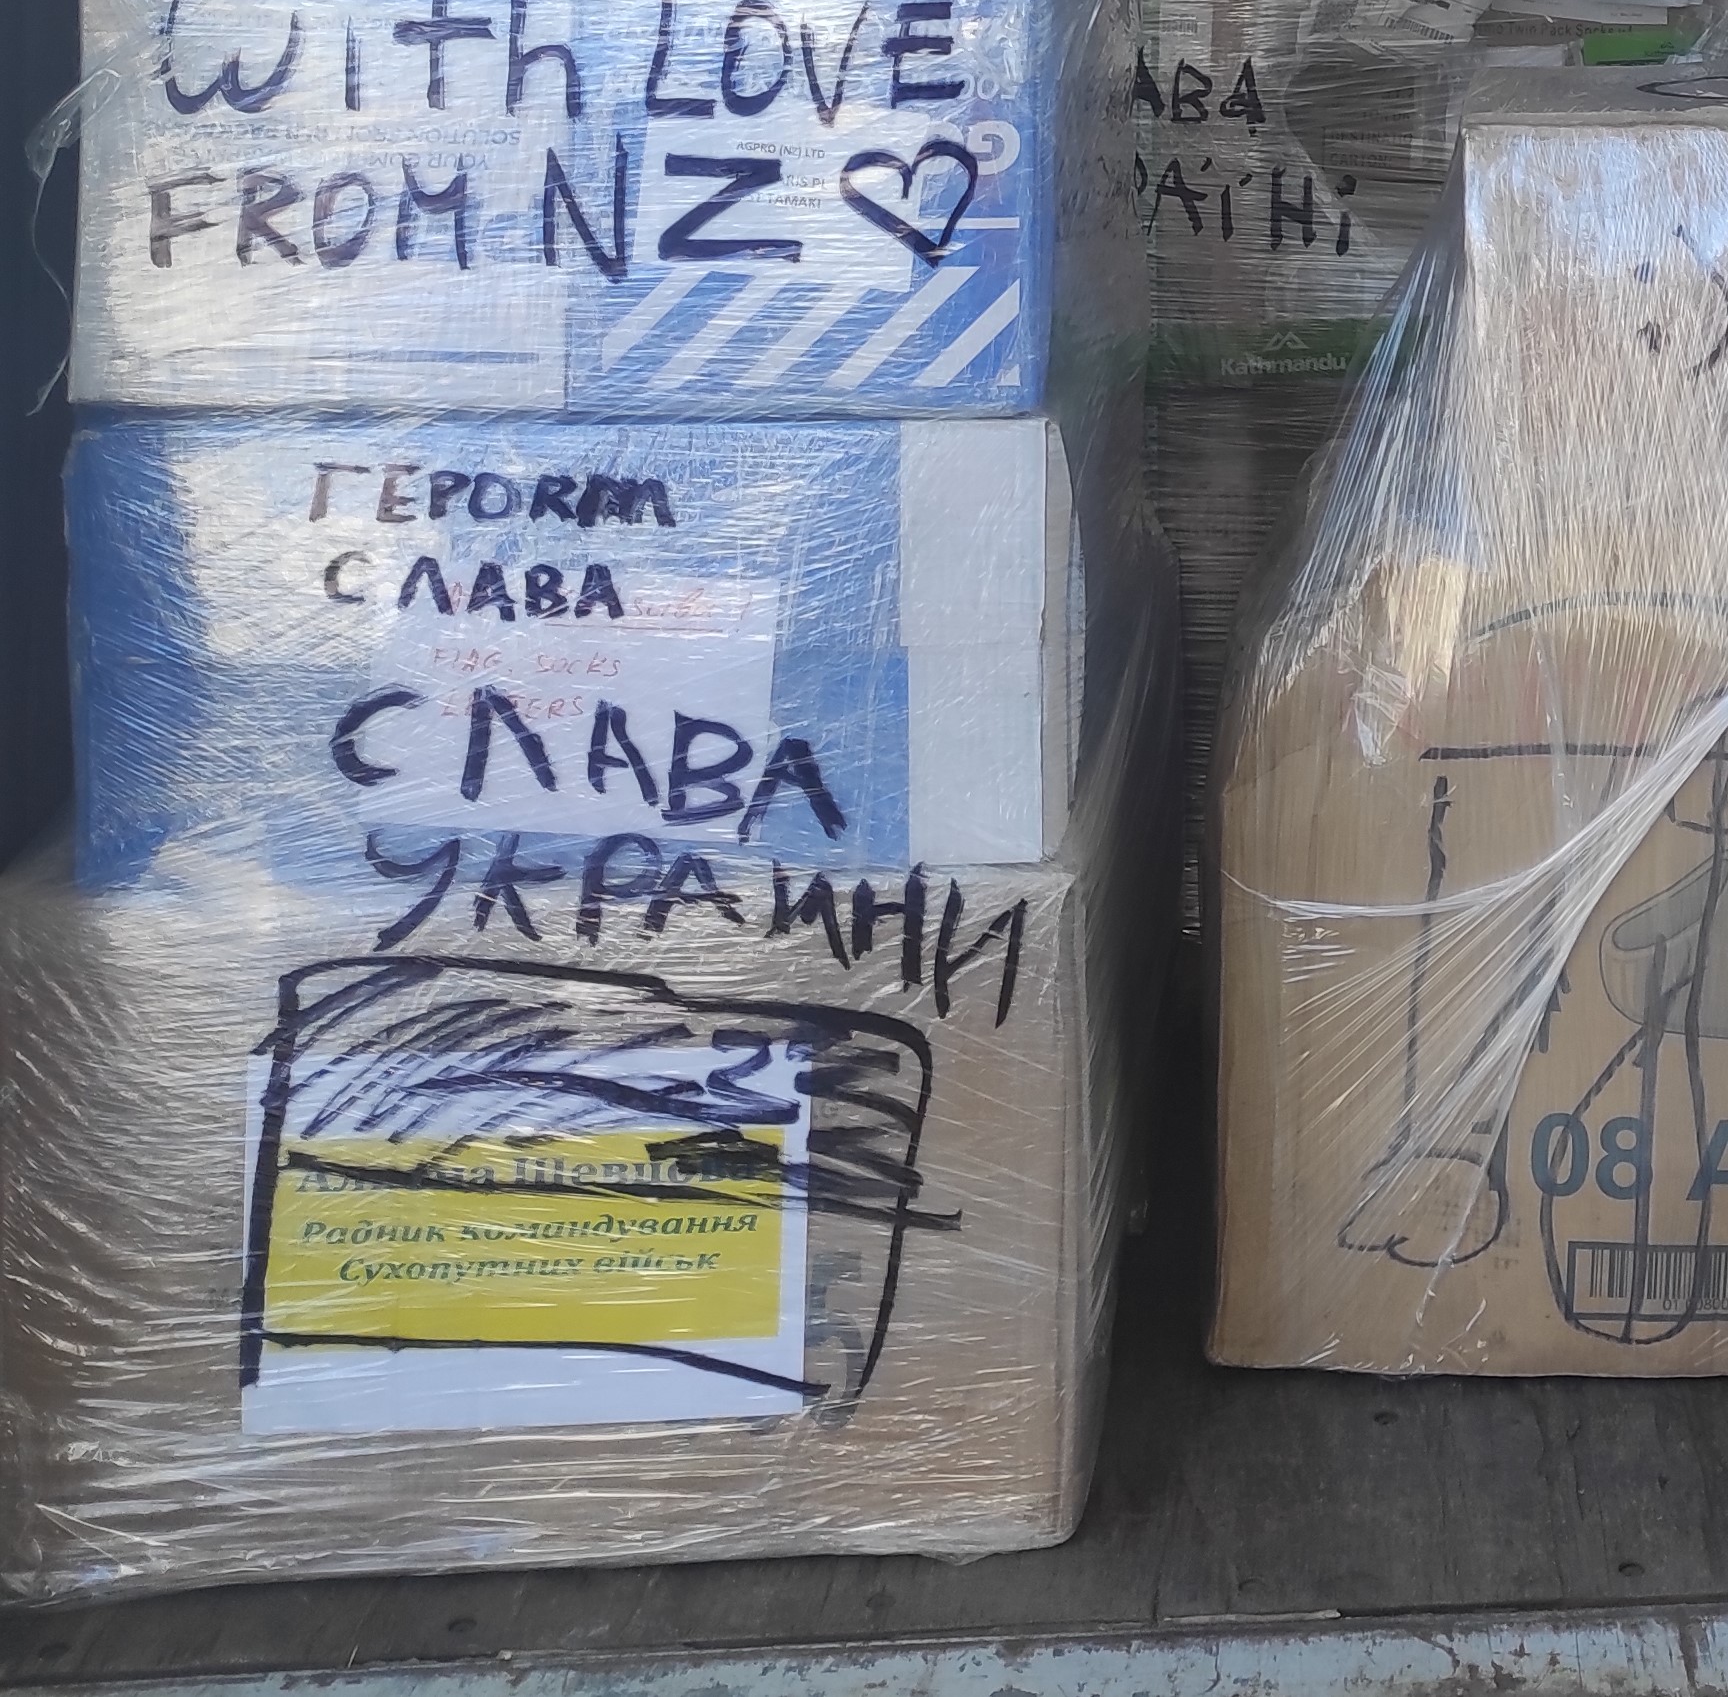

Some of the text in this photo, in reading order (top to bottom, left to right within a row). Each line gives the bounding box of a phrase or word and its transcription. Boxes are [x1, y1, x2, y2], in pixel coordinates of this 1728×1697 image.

[146, 155, 473, 272] FROM
[543, 132, 805, 284] NZ
[1219, 352, 1350, 379] Kathmandu
[322, 549, 625, 624] СЛАВА
[329, 683, 847, 846] СЛАВА
[364, 830, 1030, 1029] УКРАИНИ
[1529, 1111, 1648, 1200] 08
[302, 1212, 760, 1247] Радник командування
[339, 1256, 583, 1290] Сухопутних
